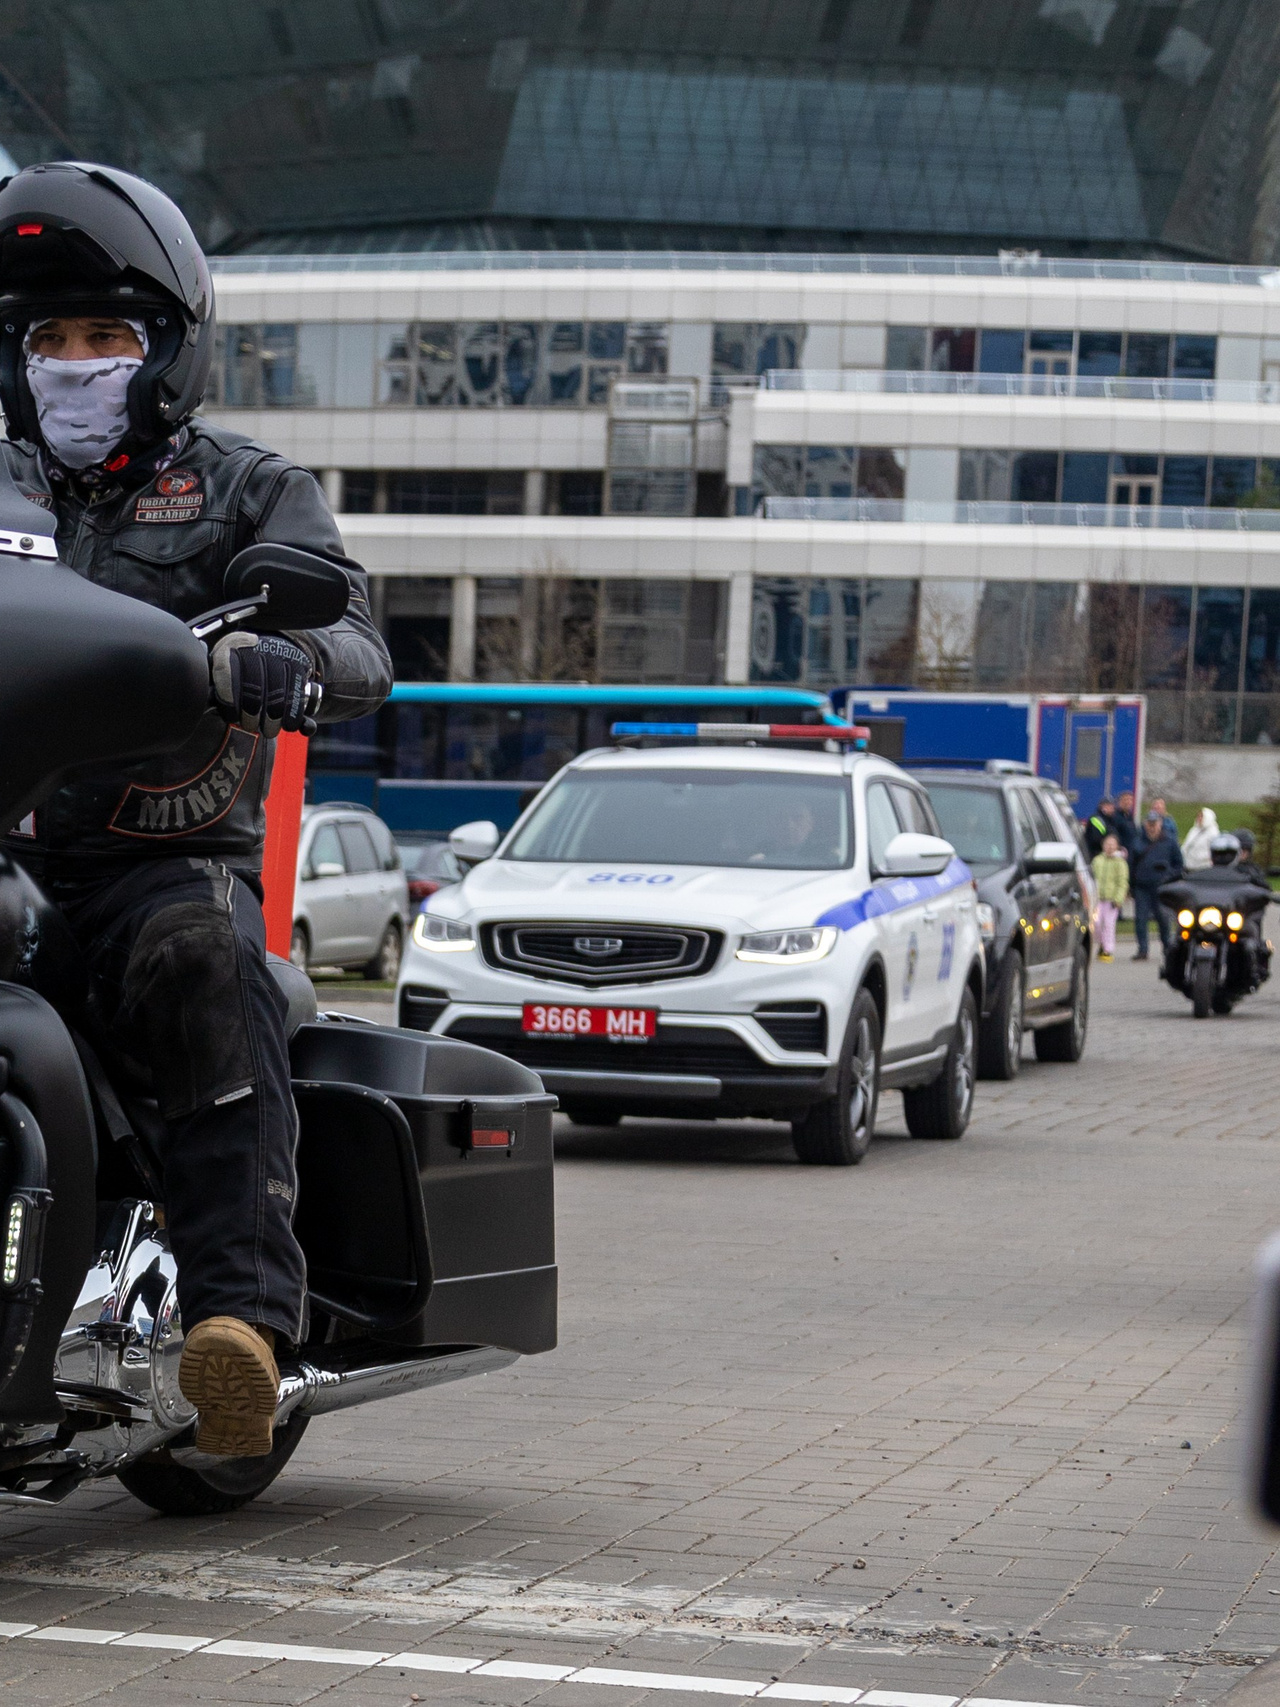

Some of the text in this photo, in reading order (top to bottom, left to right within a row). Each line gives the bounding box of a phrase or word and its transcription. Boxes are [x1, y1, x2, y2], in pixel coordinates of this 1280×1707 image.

[136, 746, 246, 830] MINSK
[587, 872, 675, 884] 860
[531, 1006, 646, 1034] 3666 MH
